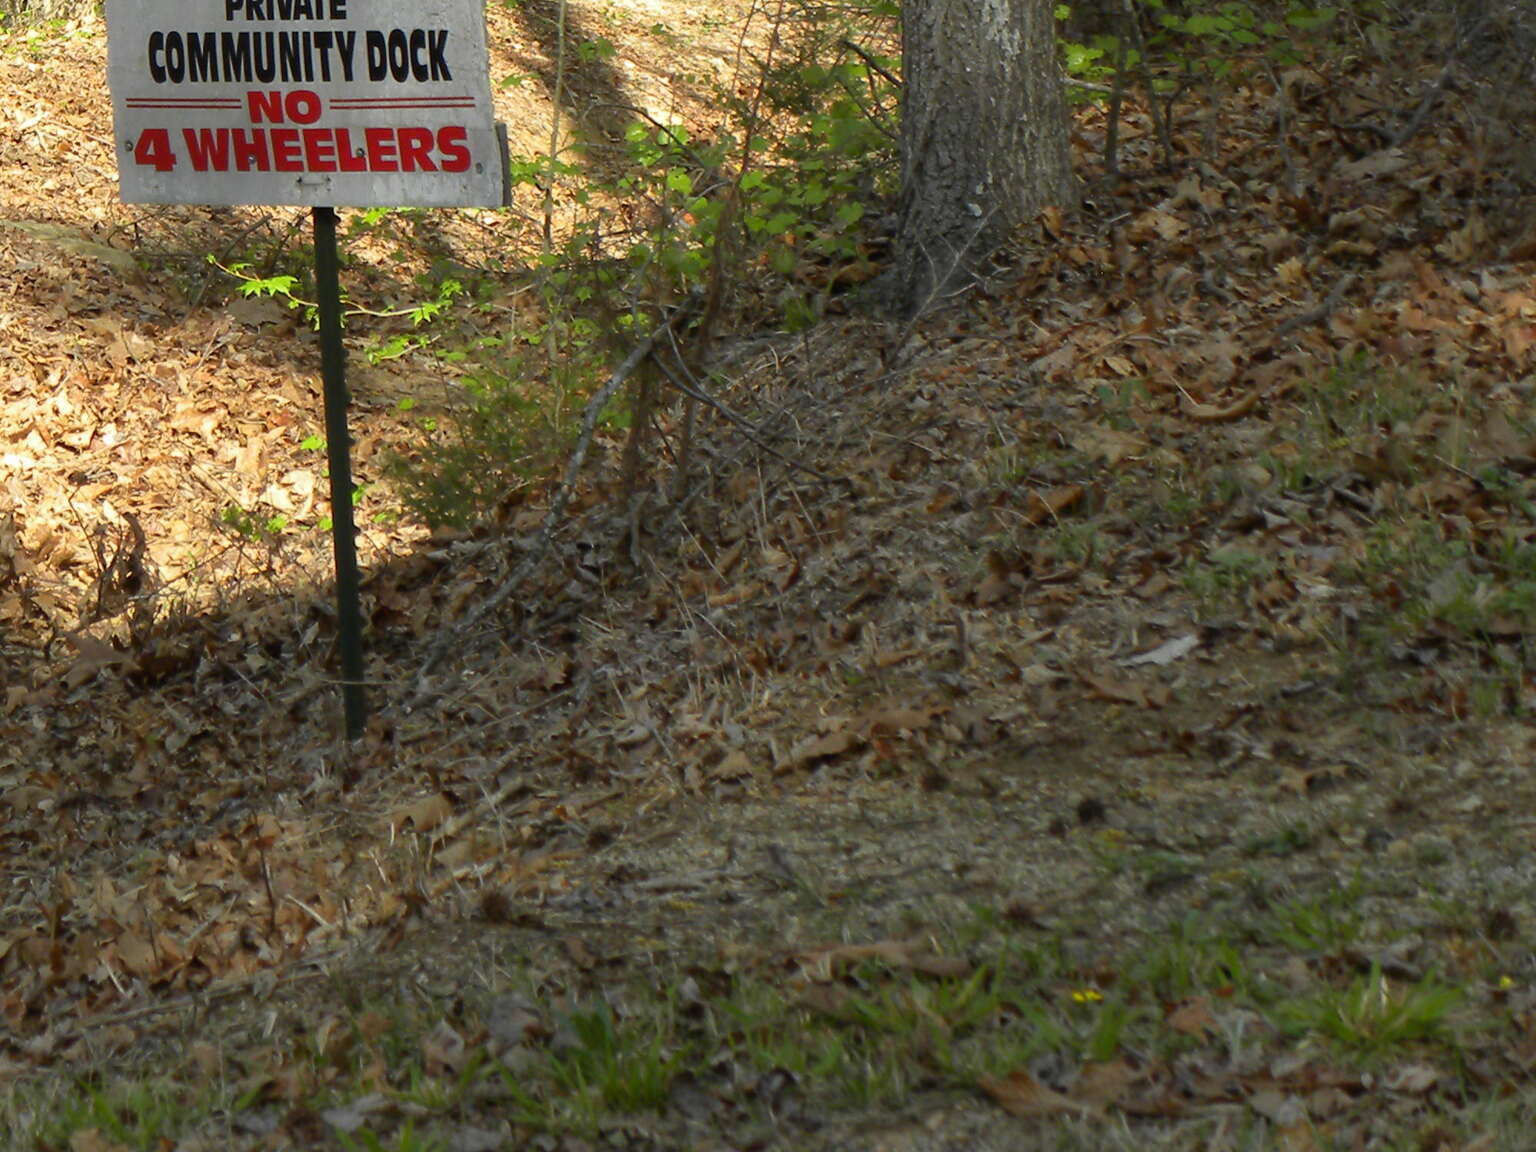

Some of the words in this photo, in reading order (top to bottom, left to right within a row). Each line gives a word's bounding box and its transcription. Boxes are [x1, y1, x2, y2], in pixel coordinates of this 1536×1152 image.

[148, 30, 356, 84] COMMUNITY
[368, 28, 453, 83] DOCK
[247, 90, 322, 125] NO
[134, 128, 177, 172] 4
[182, 125, 472, 173] WHEELERS
